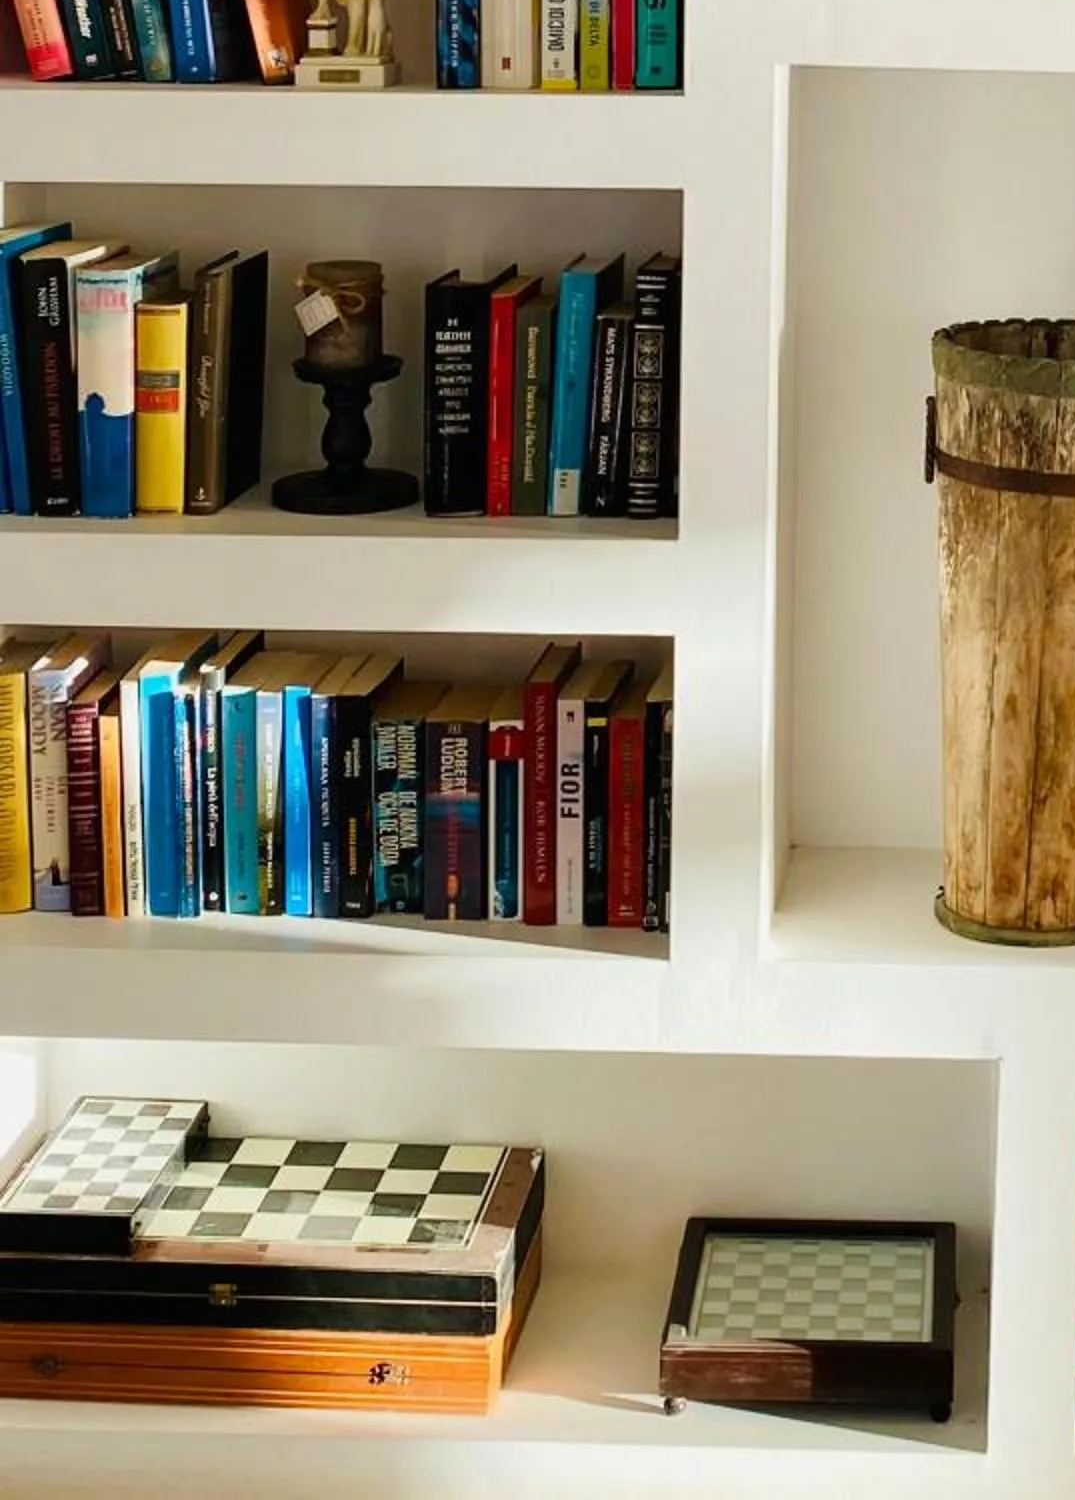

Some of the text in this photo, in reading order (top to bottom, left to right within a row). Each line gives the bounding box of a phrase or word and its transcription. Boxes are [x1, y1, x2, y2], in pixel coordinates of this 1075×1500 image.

[548, 7, 565, 52] OMICIDI
[37, 287, 48, 317] JOHN
[49, 276, 60, 327] GRISHAM
[605, 327, 617, 355] MATS
[600, 356, 616, 423] STRANDBERG
[31, 685, 47, 756] MOODY
[375, 726, 398, 771] MAILER
[397, 725, 418, 780] NORMAN
[440, 737, 454, 796] LUDLUM
[453, 737, 468, 796] ROBERT
[207, 767, 218, 779] La
[559, 762, 581, 820] FIOR
[399, 790, 418, 806] DE
[379, 819, 400, 834] DE
